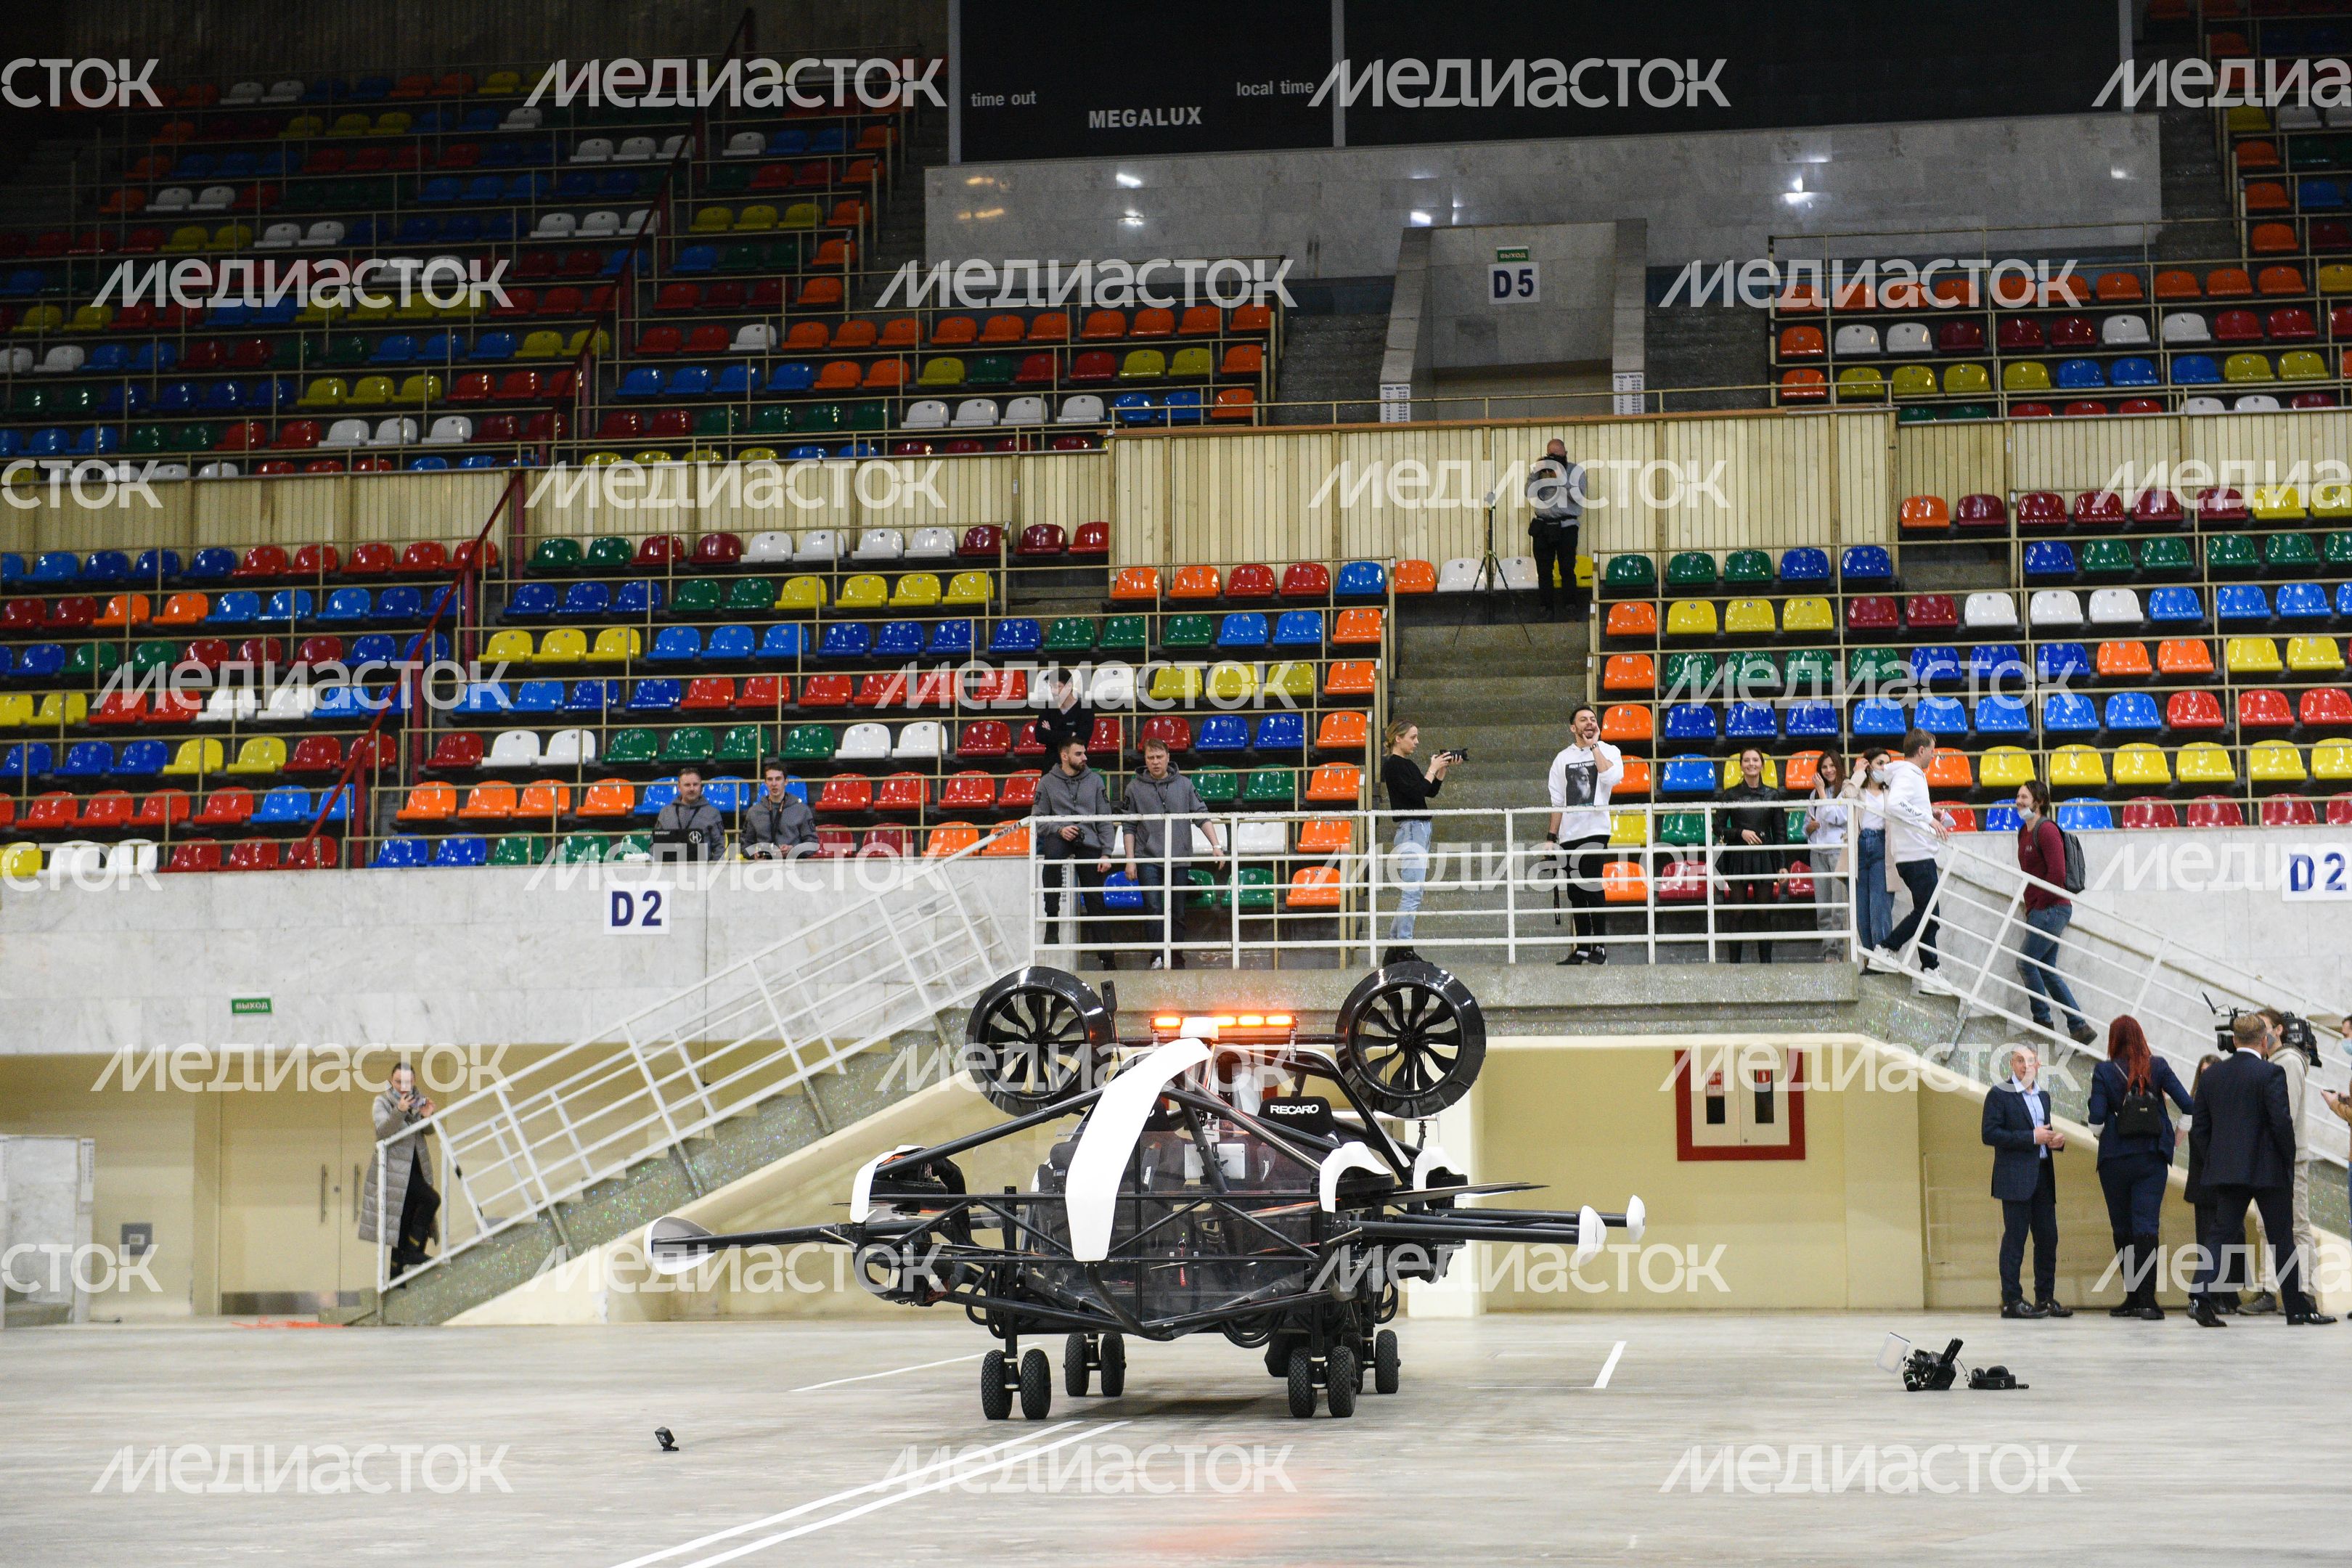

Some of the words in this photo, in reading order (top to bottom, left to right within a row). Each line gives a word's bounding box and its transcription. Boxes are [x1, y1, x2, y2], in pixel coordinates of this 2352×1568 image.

[1236, 80, 1274, 97] local
[1280, 79, 1315, 94] time
[971, 92, 1005, 107] time
[1011, 90, 1037, 105] out
[1089, 107, 1202, 128] MEGALUX
[1270, 1104, 1319, 1115] RECARO
